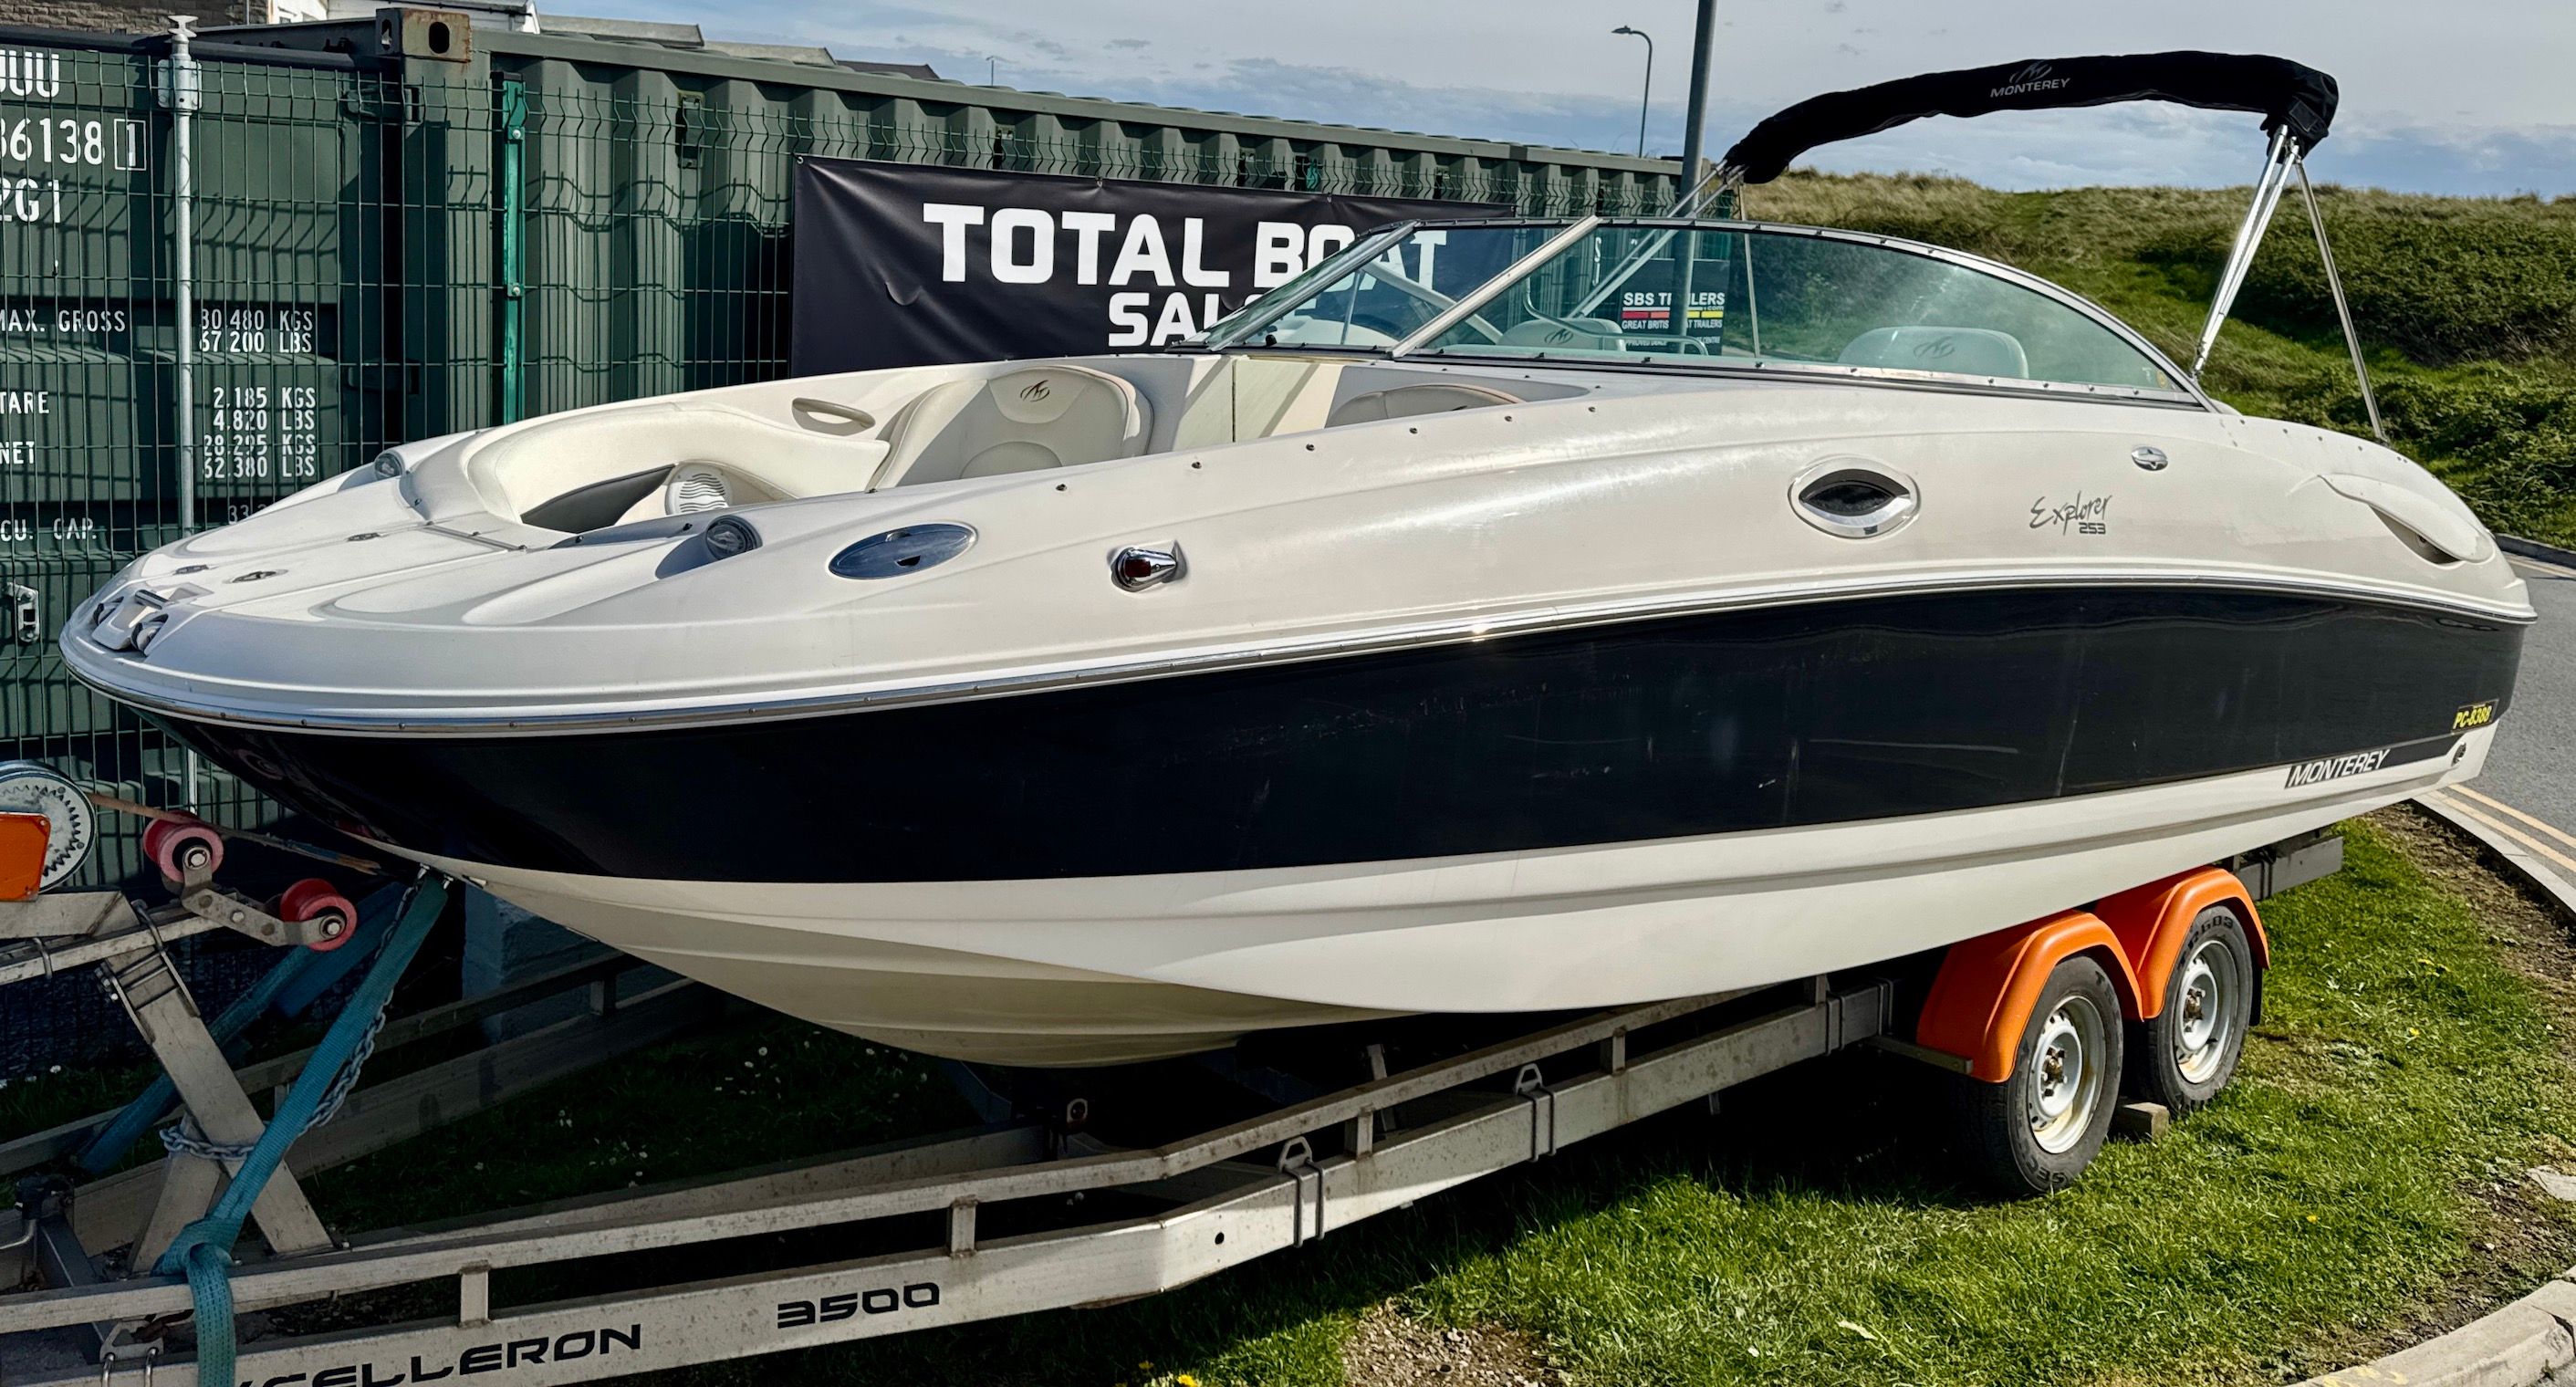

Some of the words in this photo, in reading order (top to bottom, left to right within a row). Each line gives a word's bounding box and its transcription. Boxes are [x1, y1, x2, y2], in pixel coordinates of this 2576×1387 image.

[0, 49, 60, 98] UU
[1990, 78, 2070, 98] MONTEREY
[923, 203, 1230, 287] TOTAL
[1623, 292, 1654, 306] SBS
[1658, 292, 1726, 306] TLERS
[58, 309, 126, 332] GROSS
[279, 311, 313, 331] KGS
[1622, 319, 1646, 329] GREAT
[1647, 319, 1670, 329] BRITIS
[1694, 319, 1723, 328] TRAILERS
[279, 332, 312, 353] LBS
[0, 391, 50, 414] TARE
[282, 388, 316, 409] KGS
[282, 411, 315, 431] LBS
[0, 441, 35, 464] NET
[282, 434, 316, 455] KGS
[282, 457, 315, 478] LBS
[2028, 490, 2112, 536] Explorer
[0, 519, 34, 542] CU.
[53, 517, 97, 540] CAP.
[2079, 522, 2106, 535] 253
[2286, 748, 2391, 788] MONTEREY
[777, 1282, 940, 1330] 3500
[239, 1323, 641, 1387] ELLERON
